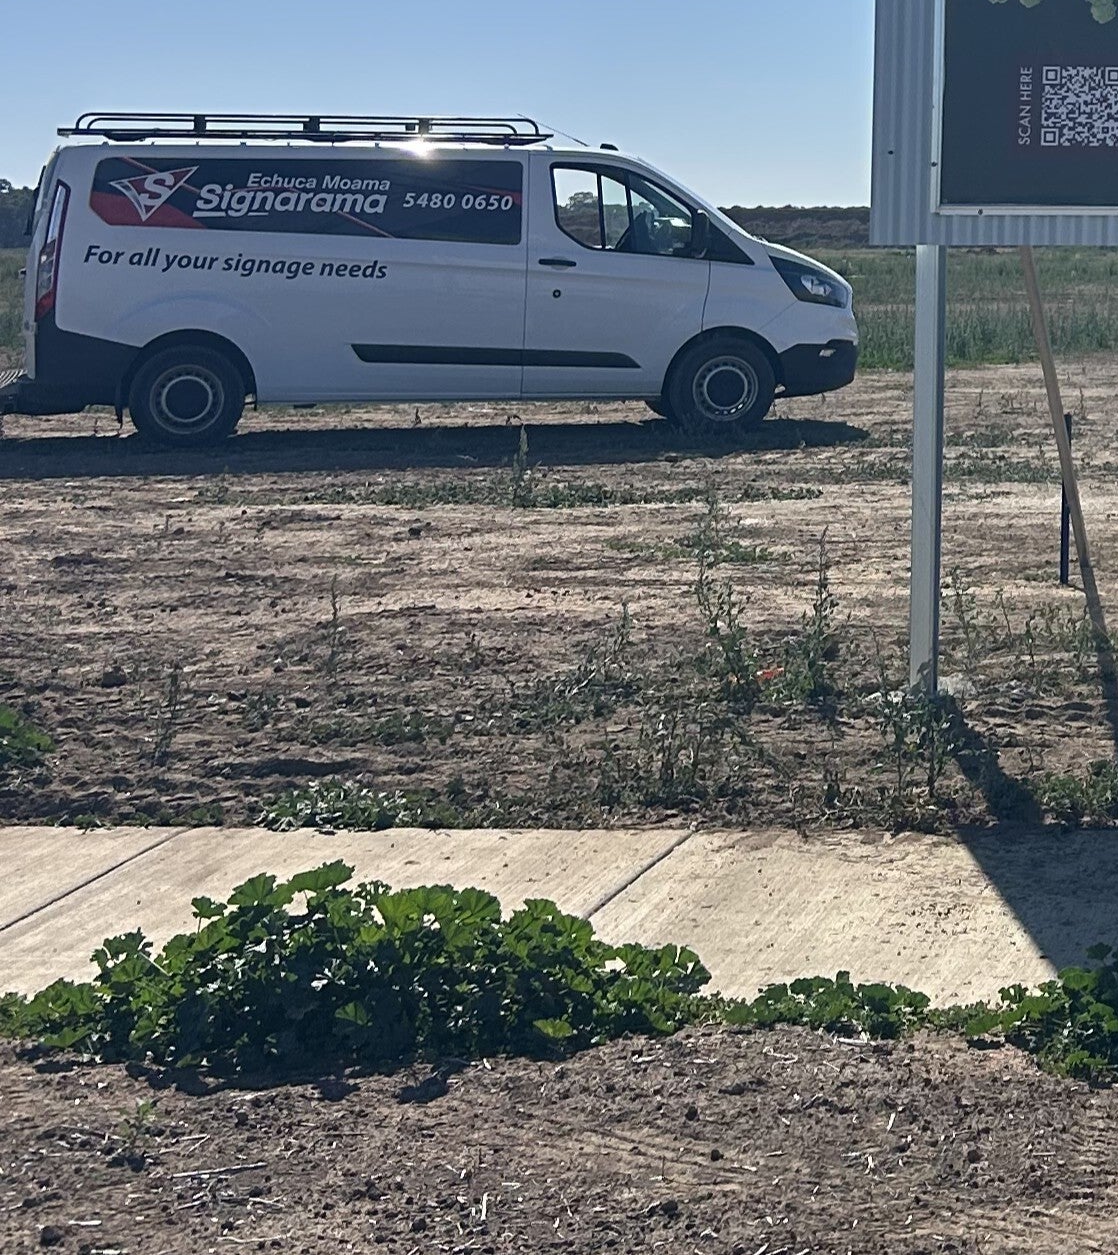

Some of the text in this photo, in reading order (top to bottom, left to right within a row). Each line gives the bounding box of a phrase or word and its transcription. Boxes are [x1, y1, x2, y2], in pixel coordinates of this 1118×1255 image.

[1018, 67, 1033, 145] SCAN HERE
[247, 173, 391, 191] Echuca Moama
[195, 183, 388, 217] Signarama
[402, 193, 514, 211] 5480 0650
[83, 245, 388, 280] For all your signage needs
